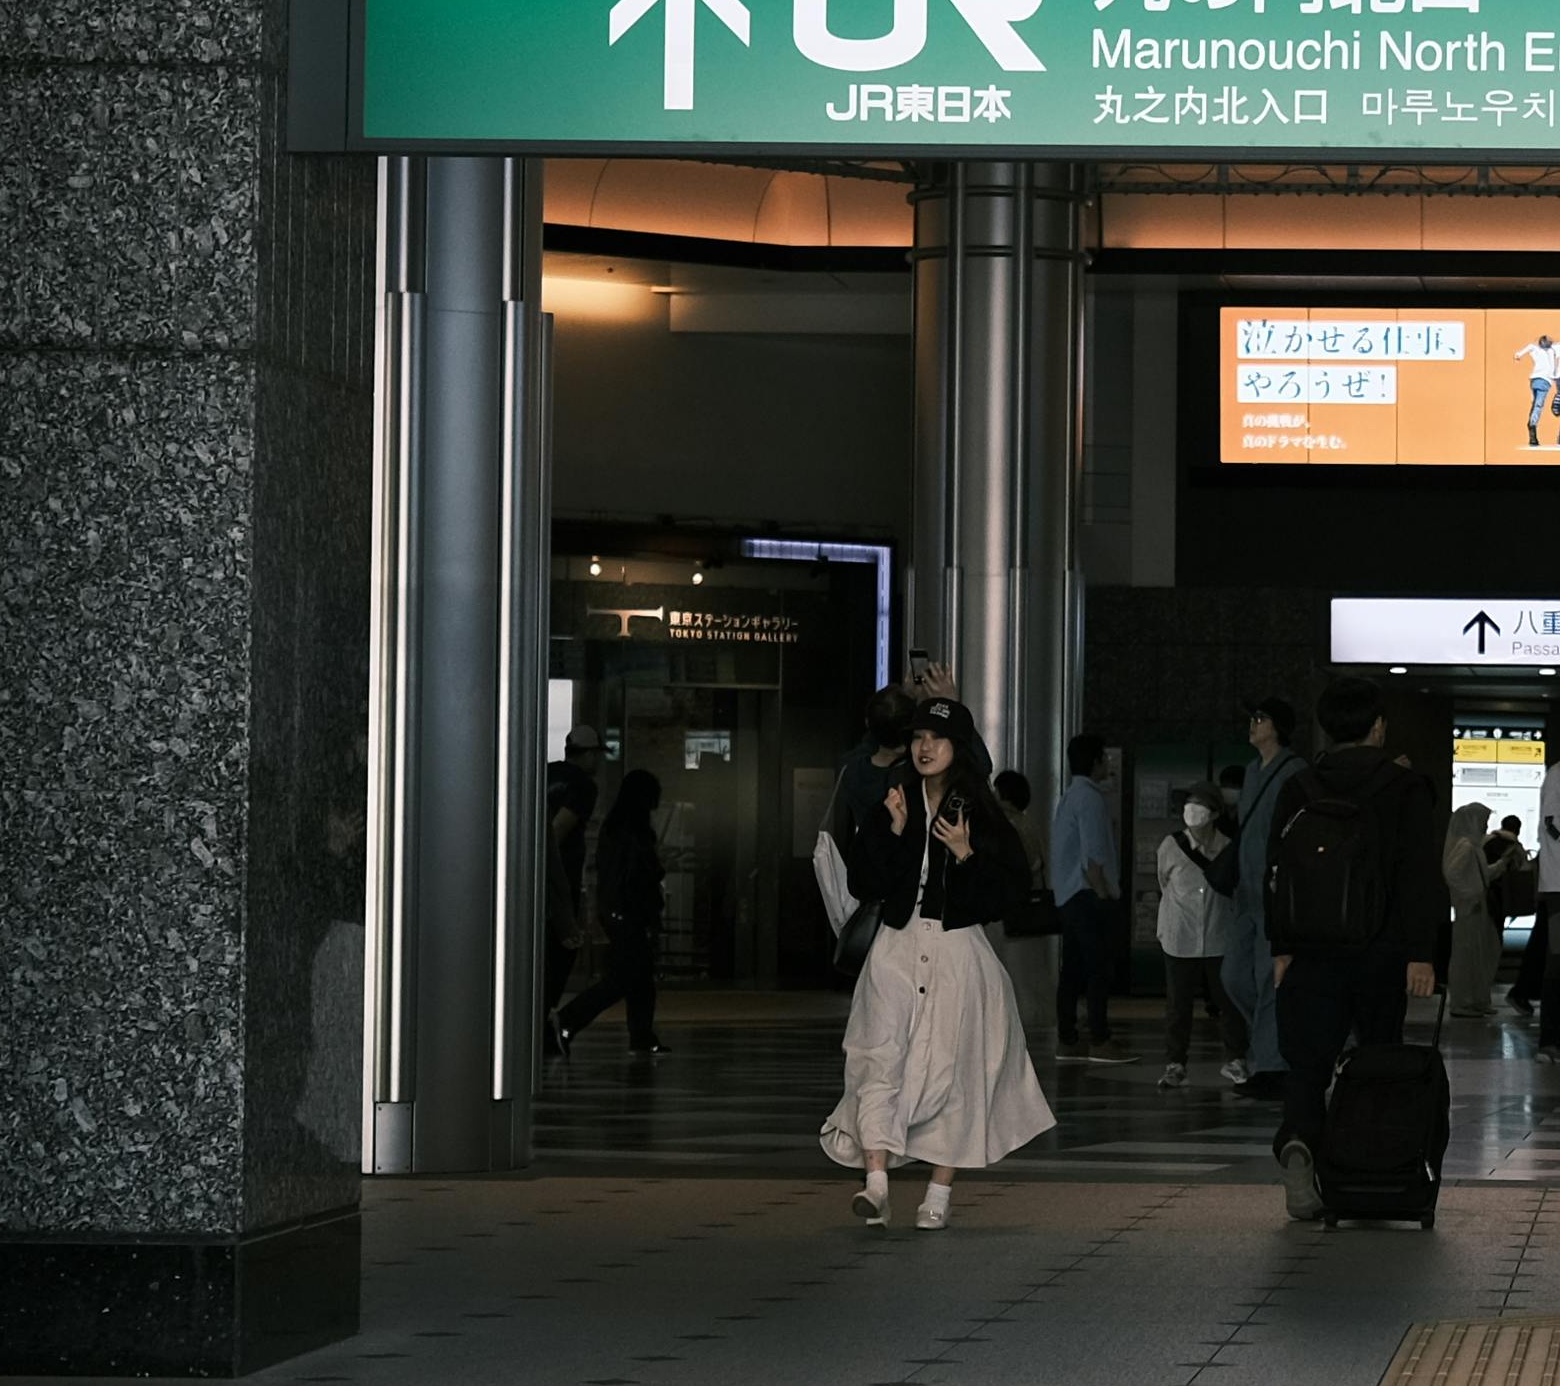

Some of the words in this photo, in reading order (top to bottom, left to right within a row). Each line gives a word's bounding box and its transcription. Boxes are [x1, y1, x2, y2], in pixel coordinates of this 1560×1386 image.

[1092, 28, 1360, 71] Marunouchi
[1379, 30, 1505, 72] North
[826, 84, 1011, 123] JR東日本
[1093, 85, 1328, 125] 丸之内北入口
[1362, 88, 1555, 127] 마루노우치
[669, 611, 798, 630] 東京ステーションギャラリー
[669, 629, 703, 639] TOKYO
[707, 630, 750, 641] STATION
[754, 631, 798, 643] GALLERY
